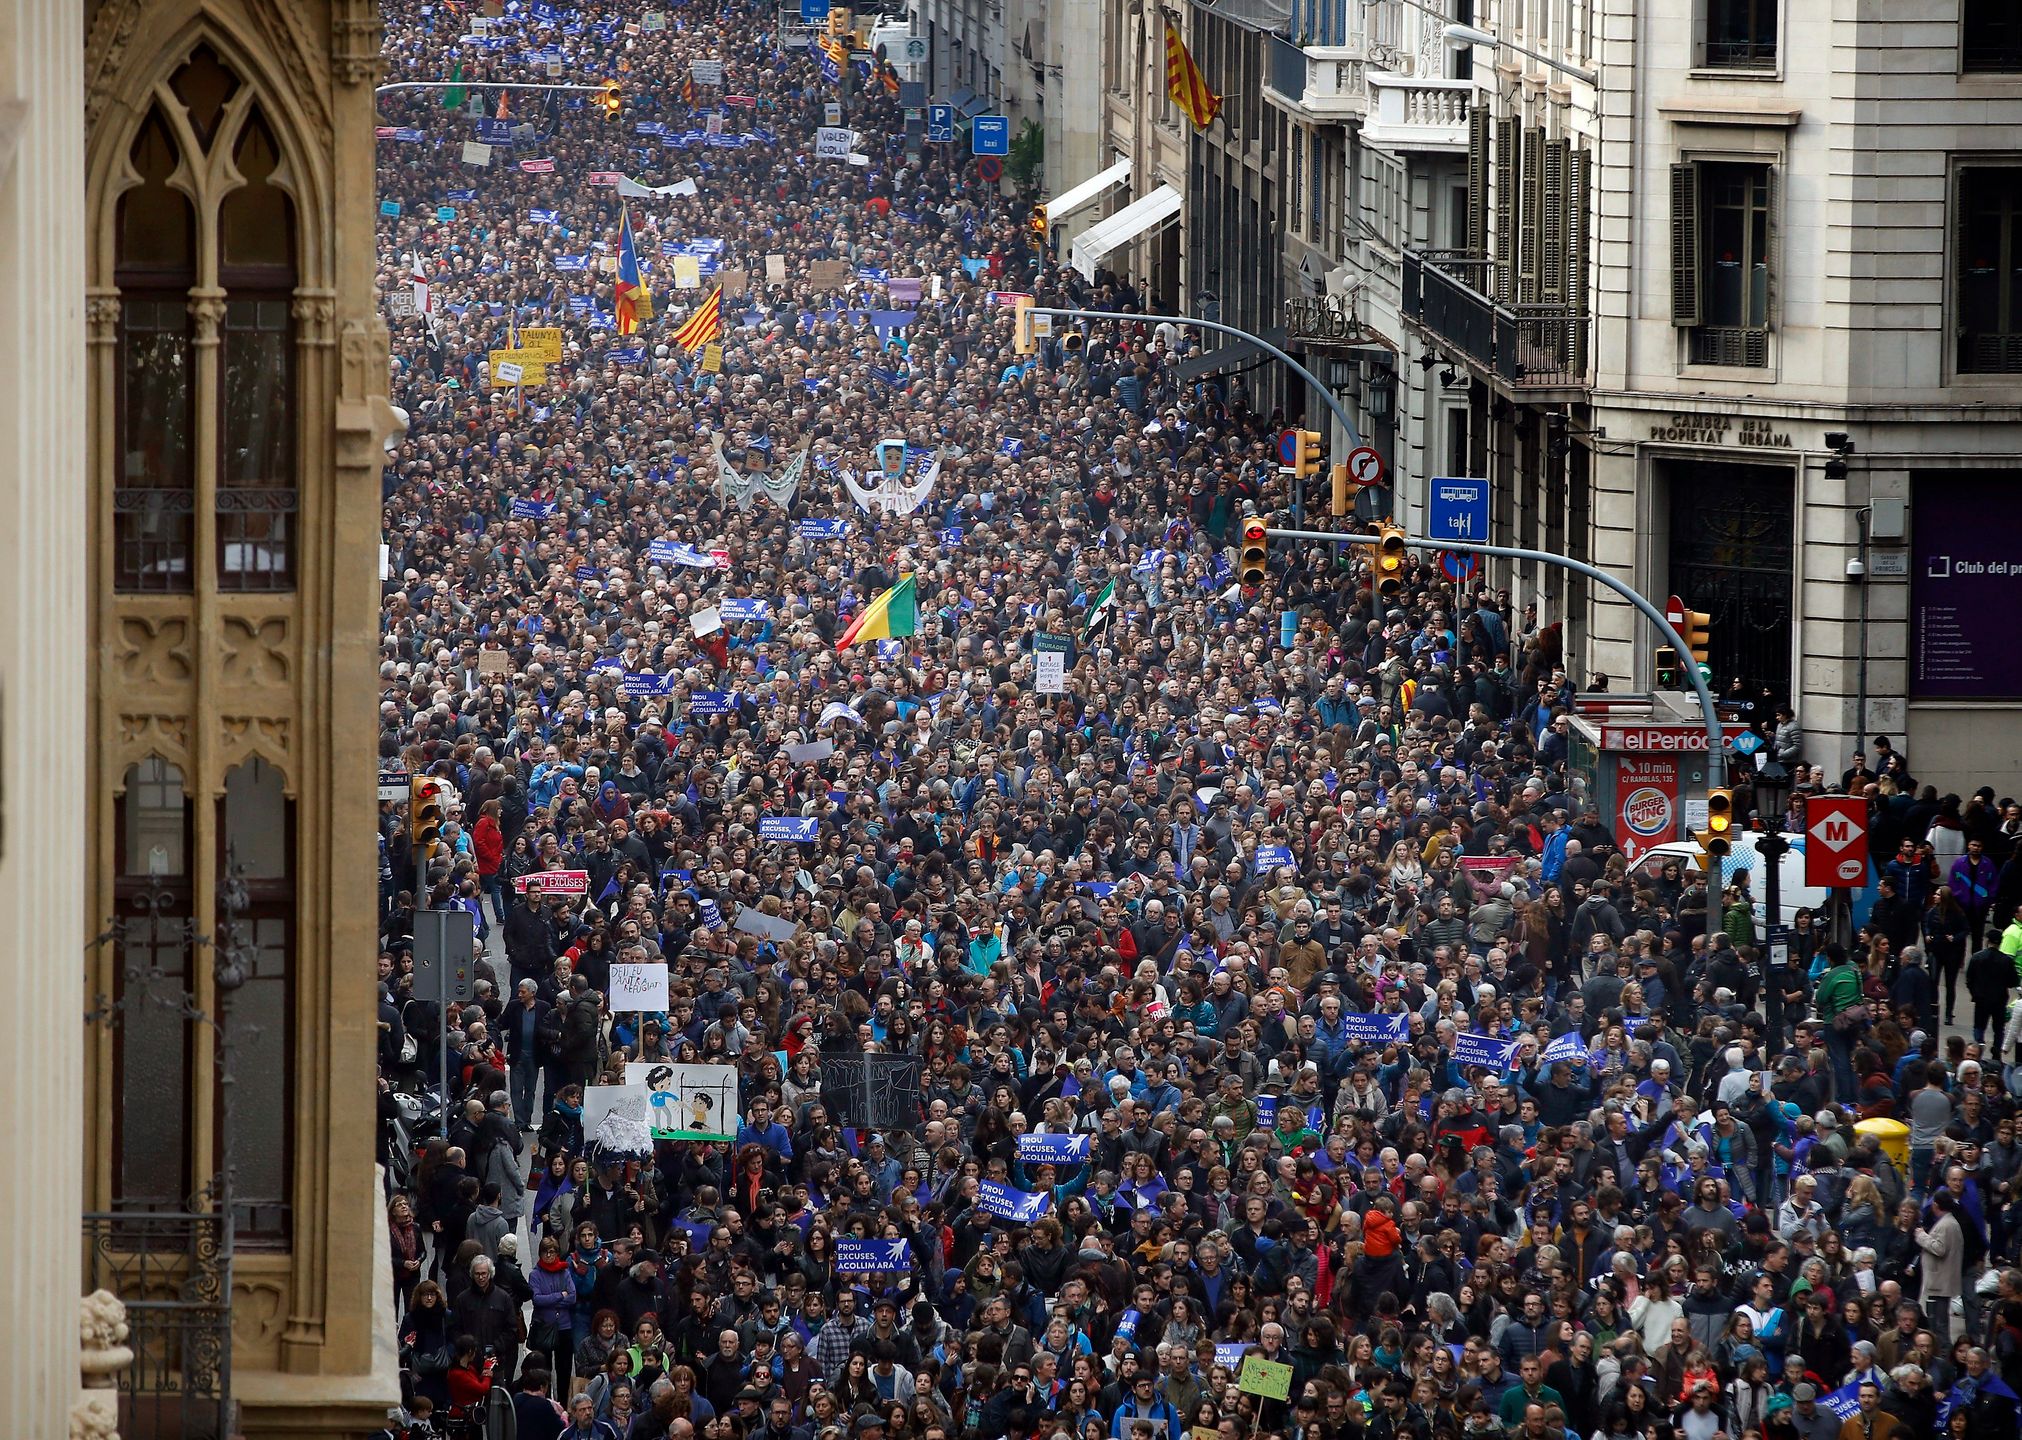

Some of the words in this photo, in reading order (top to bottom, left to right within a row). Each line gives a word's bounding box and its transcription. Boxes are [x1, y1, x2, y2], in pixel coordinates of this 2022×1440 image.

[935, 109, 945, 121] P
[391, 292, 442, 305] REFUES
[1672, 415, 1731, 430] CAMBRA
[1759, 421, 1772, 432] LA
[1650, 427, 1724, 443] PROPIETAT
[1739, 432, 1792, 447] URBANA
[1956, 561, 1984, 574] Club
[1988, 561, 2008, 574] del
[1625, 731, 1643, 749] el
[1647, 730, 1736, 749] Perióc
[1638, 763, 1650, 774] 10
[1653, 763, 1675, 774] min.
[1630, 797, 1665, 813] BURGER
[1631, 804, 1667, 825] KING
[761, 826, 791, 834] EXCUSES,
[1826, 822, 1848, 841] M
[549, 878, 584, 888] EXCUSES
[1346, 1024, 1379, 1033] EXCUSES,
[1457, 1038, 1478, 1047] PROU
[1456, 1047, 1490, 1058] EXCUSES,
[1549, 1050, 1575, 1060] COLLIM
[1455, 1055, 1487, 1065] ACOLLIM
[1020, 1145, 1057, 1154] EXCUSES,
[981, 1184, 1004, 1196] PROU
[979, 1193, 1015, 1210] EXCUSES,
[977, 1202, 1012, 1217] ACOLLIM
[1012, 1211, 1030, 1220] ARA
[837, 1243, 862, 1251] PROU
[837, 1252, 878, 1261] EXCUSES,
[837, 1262, 876, 1270] ACOLLIM
[877, 1262, 895, 1270] ARA
